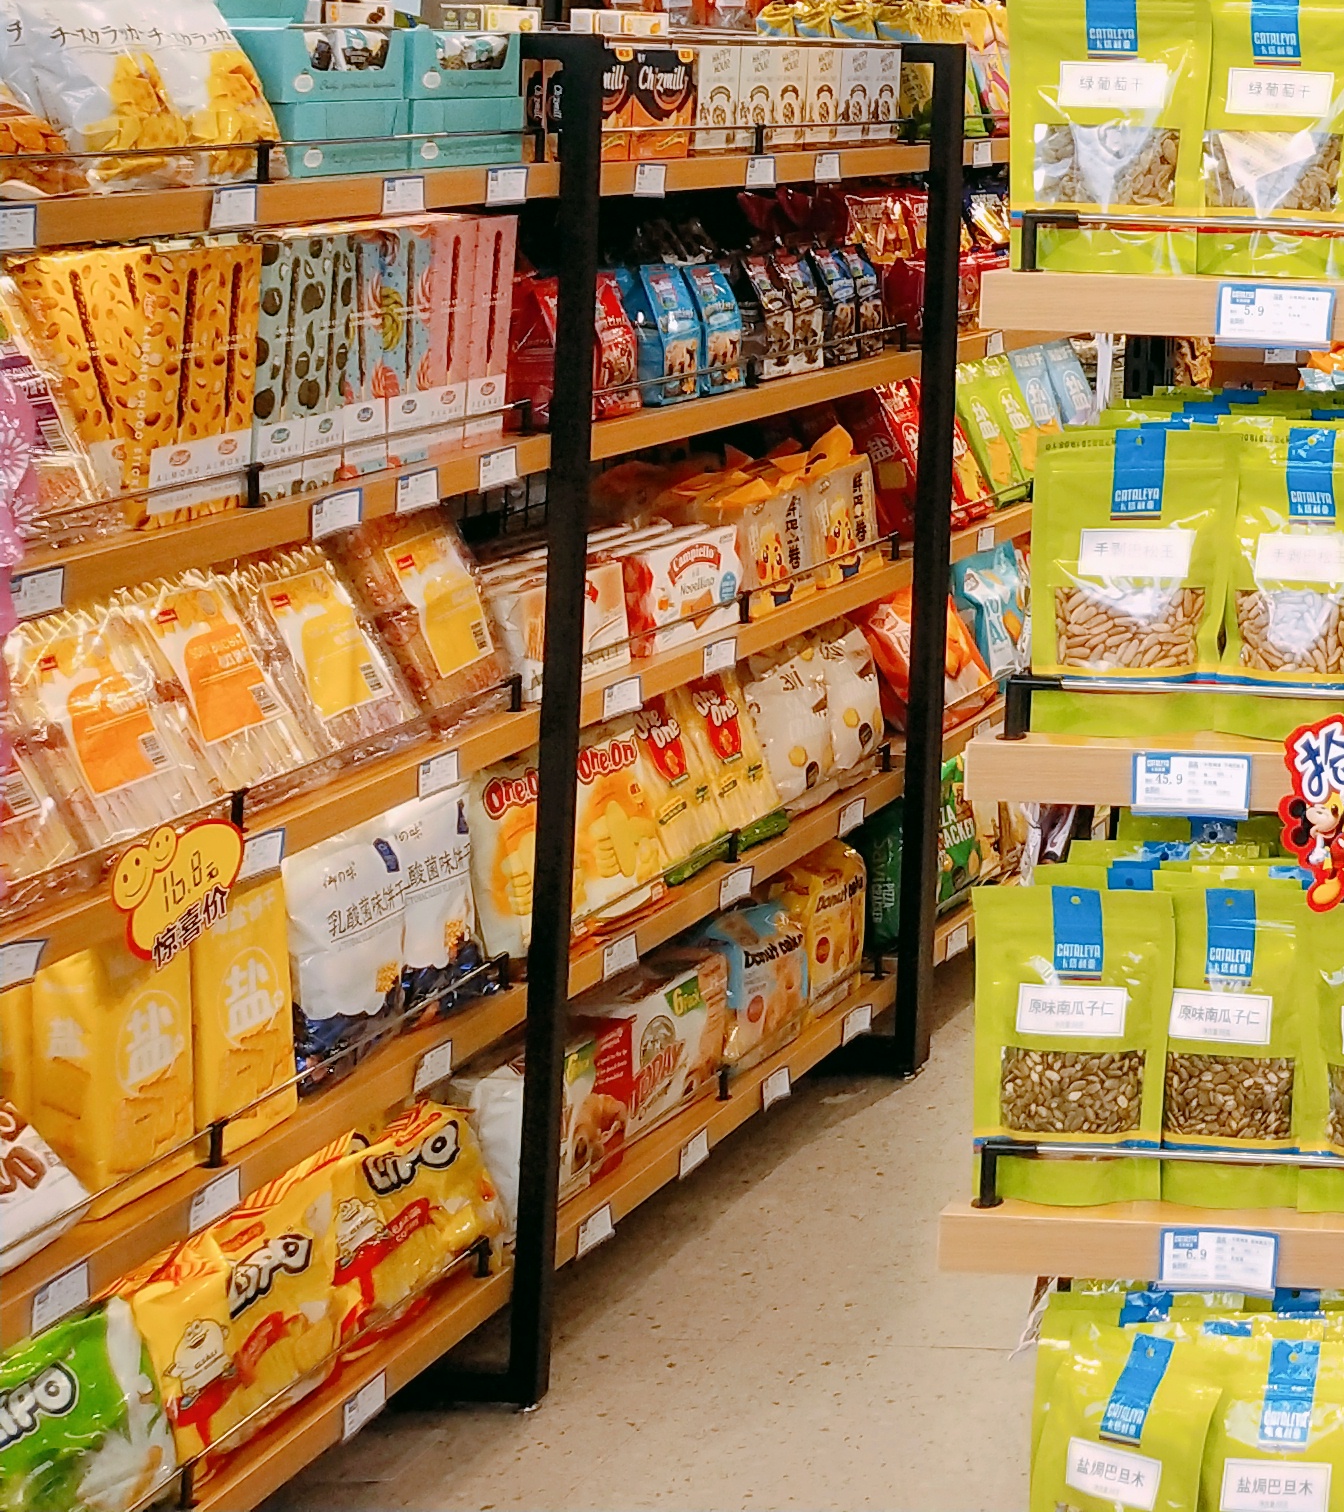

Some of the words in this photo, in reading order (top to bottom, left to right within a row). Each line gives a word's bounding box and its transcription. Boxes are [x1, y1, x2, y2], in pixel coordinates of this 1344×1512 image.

[1079, 74, 1145, 93] 绿葡萄干
[1247, 80, 1313, 100] 绿葡萄干
[673, 544, 715, 572] Campiello
[1154, 771, 1184, 786] 45.9
[326, 879, 407, 938] 乳酸菌味饼干
[150, 886, 229, 968] 惊喜价
[221, 957, 281, 1046] 盐
[1027, 998, 1116, 1017] 原味南瓜子仁
[1176, 1005, 1262, 1026] 原味南瓜子仁
[365, 1118, 461, 1197] LIPO
[1184, 1246, 1208, 1261] 6.9
[1076, 1456, 1146, 1489] 盐焗巴旦木
[1235, 1476, 1315, 1497] 盐焗巴旦木
